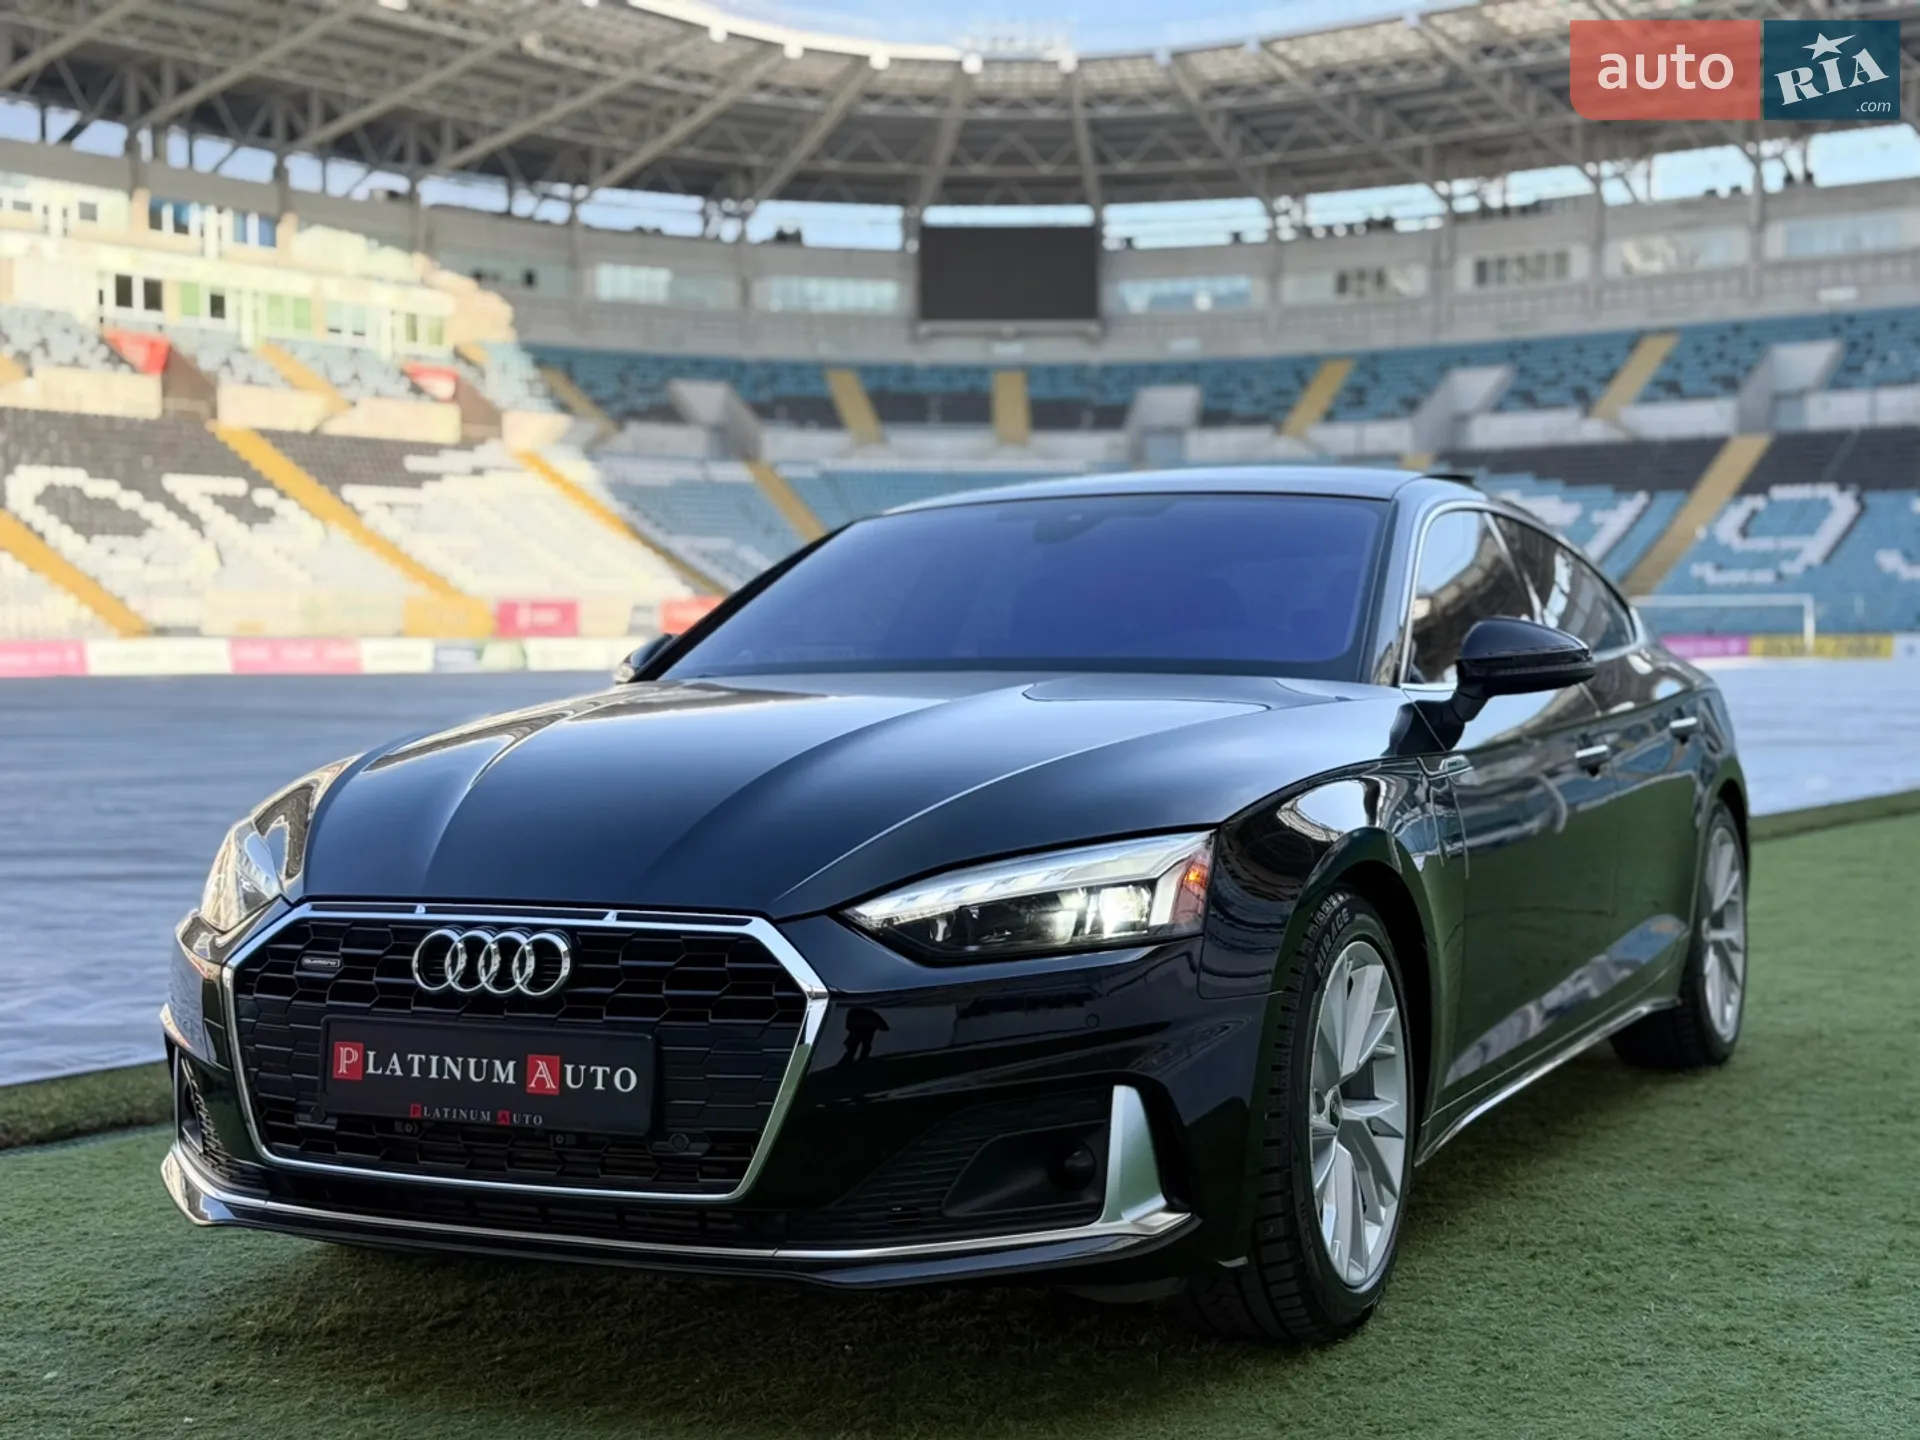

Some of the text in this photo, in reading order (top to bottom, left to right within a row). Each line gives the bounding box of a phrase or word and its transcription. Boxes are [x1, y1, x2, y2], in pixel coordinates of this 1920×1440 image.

[1314, 907, 1351, 977] MIRAGE
[335, 1044, 638, 1093] PLATINUM AUTO
